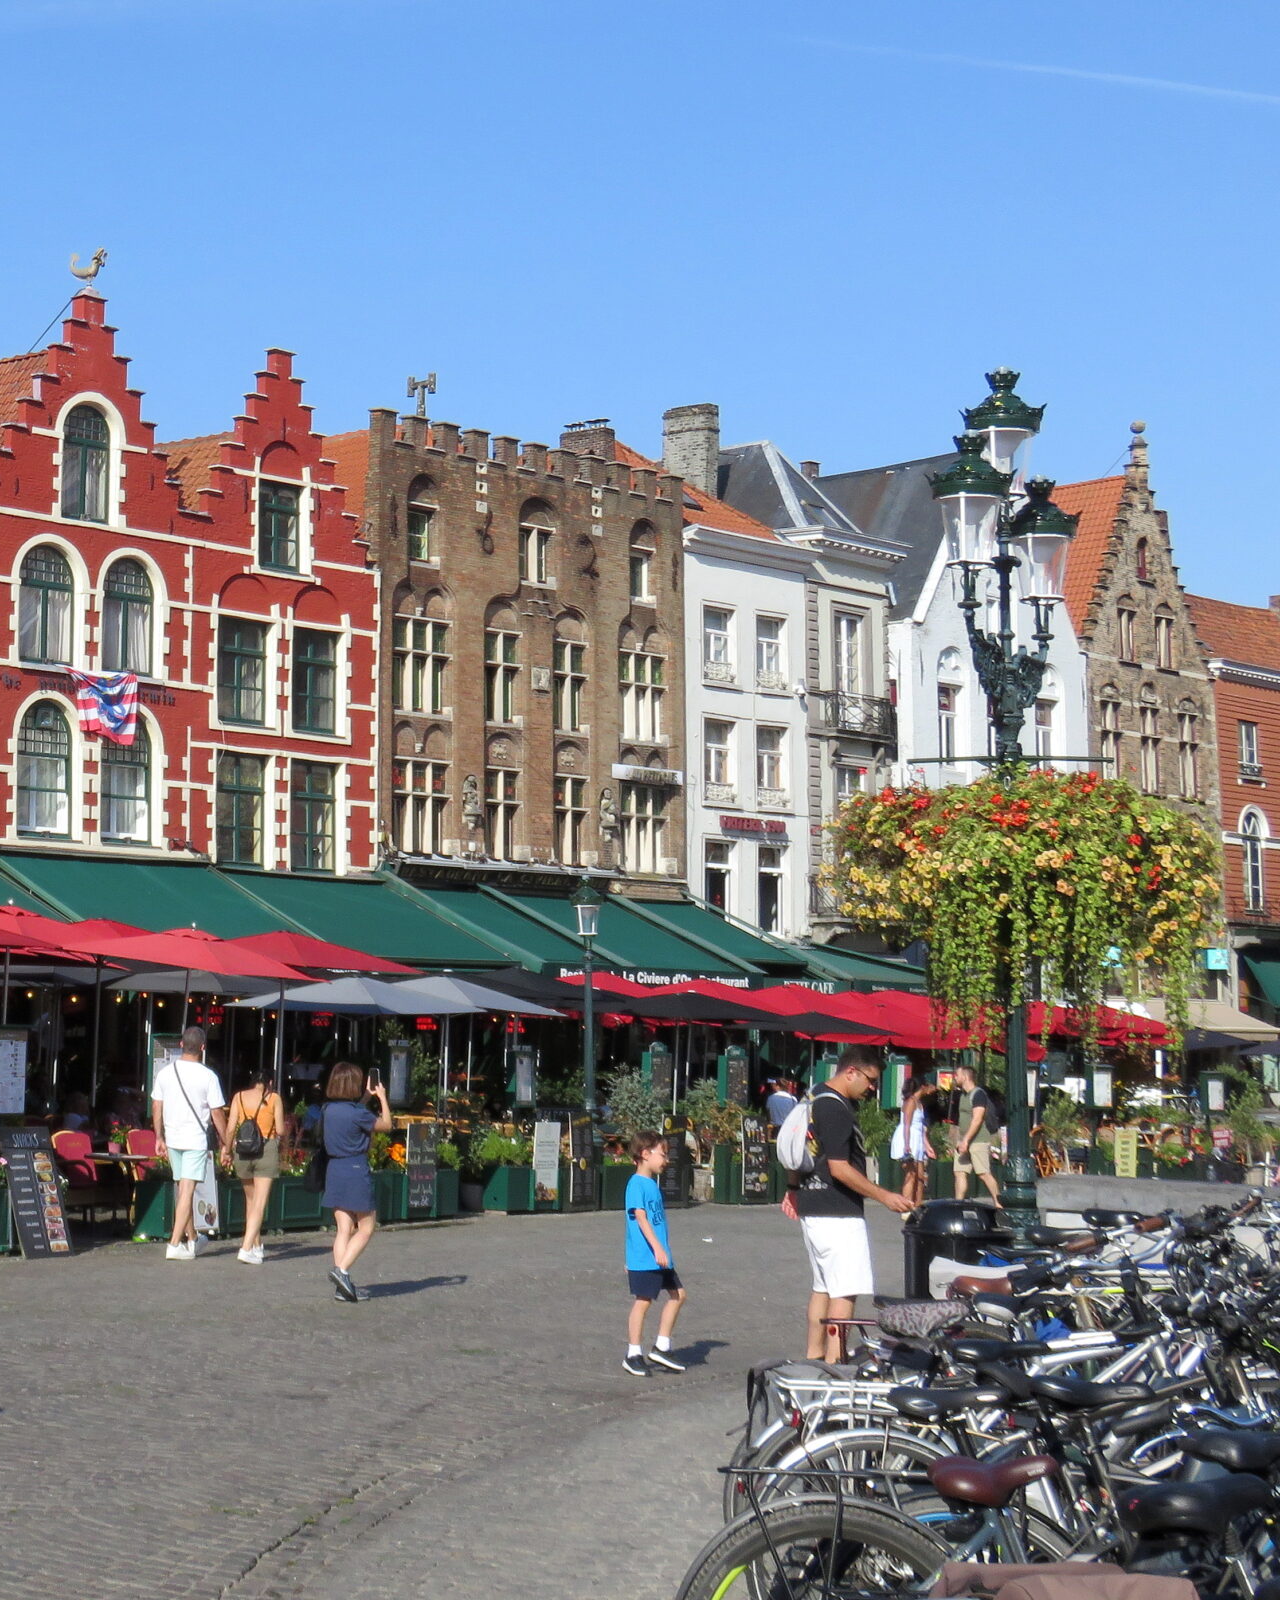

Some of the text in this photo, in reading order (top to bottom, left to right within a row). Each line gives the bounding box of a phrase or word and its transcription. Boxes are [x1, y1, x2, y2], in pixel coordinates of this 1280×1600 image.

[623, 971, 635, 982] La
[637, 971, 670, 985] Civiere
[12, 1133, 39, 1148] SNACKS
